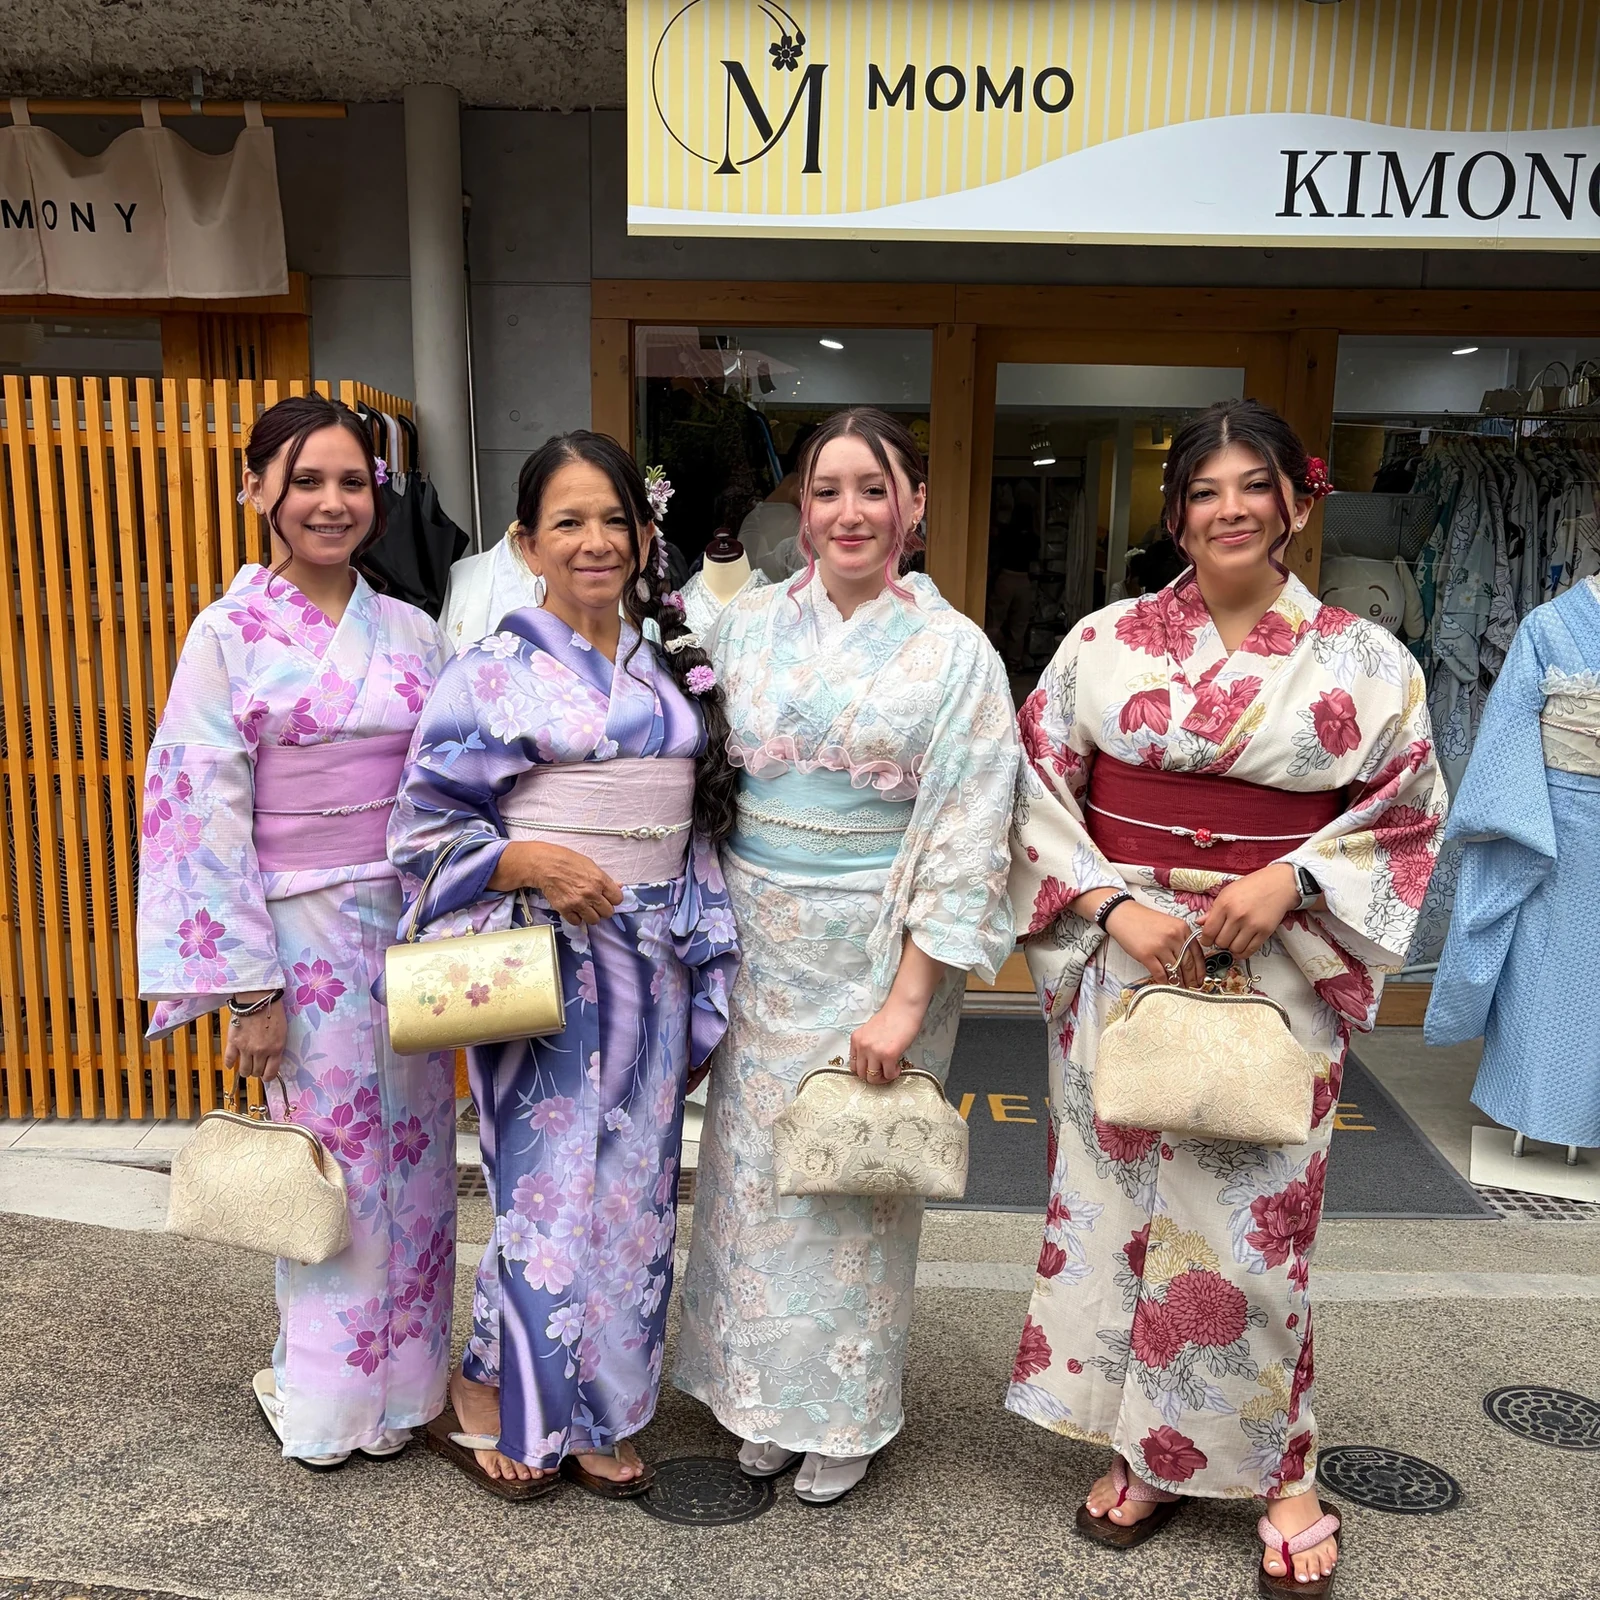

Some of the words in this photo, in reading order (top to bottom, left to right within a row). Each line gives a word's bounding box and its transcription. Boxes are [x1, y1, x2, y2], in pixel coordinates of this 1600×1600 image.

[713, 60, 828, 174] M
[868, 64, 1074, 113] MOMO
[1275, 149, 1600, 220] KIMON
[0, 199, 138, 233] MONY
